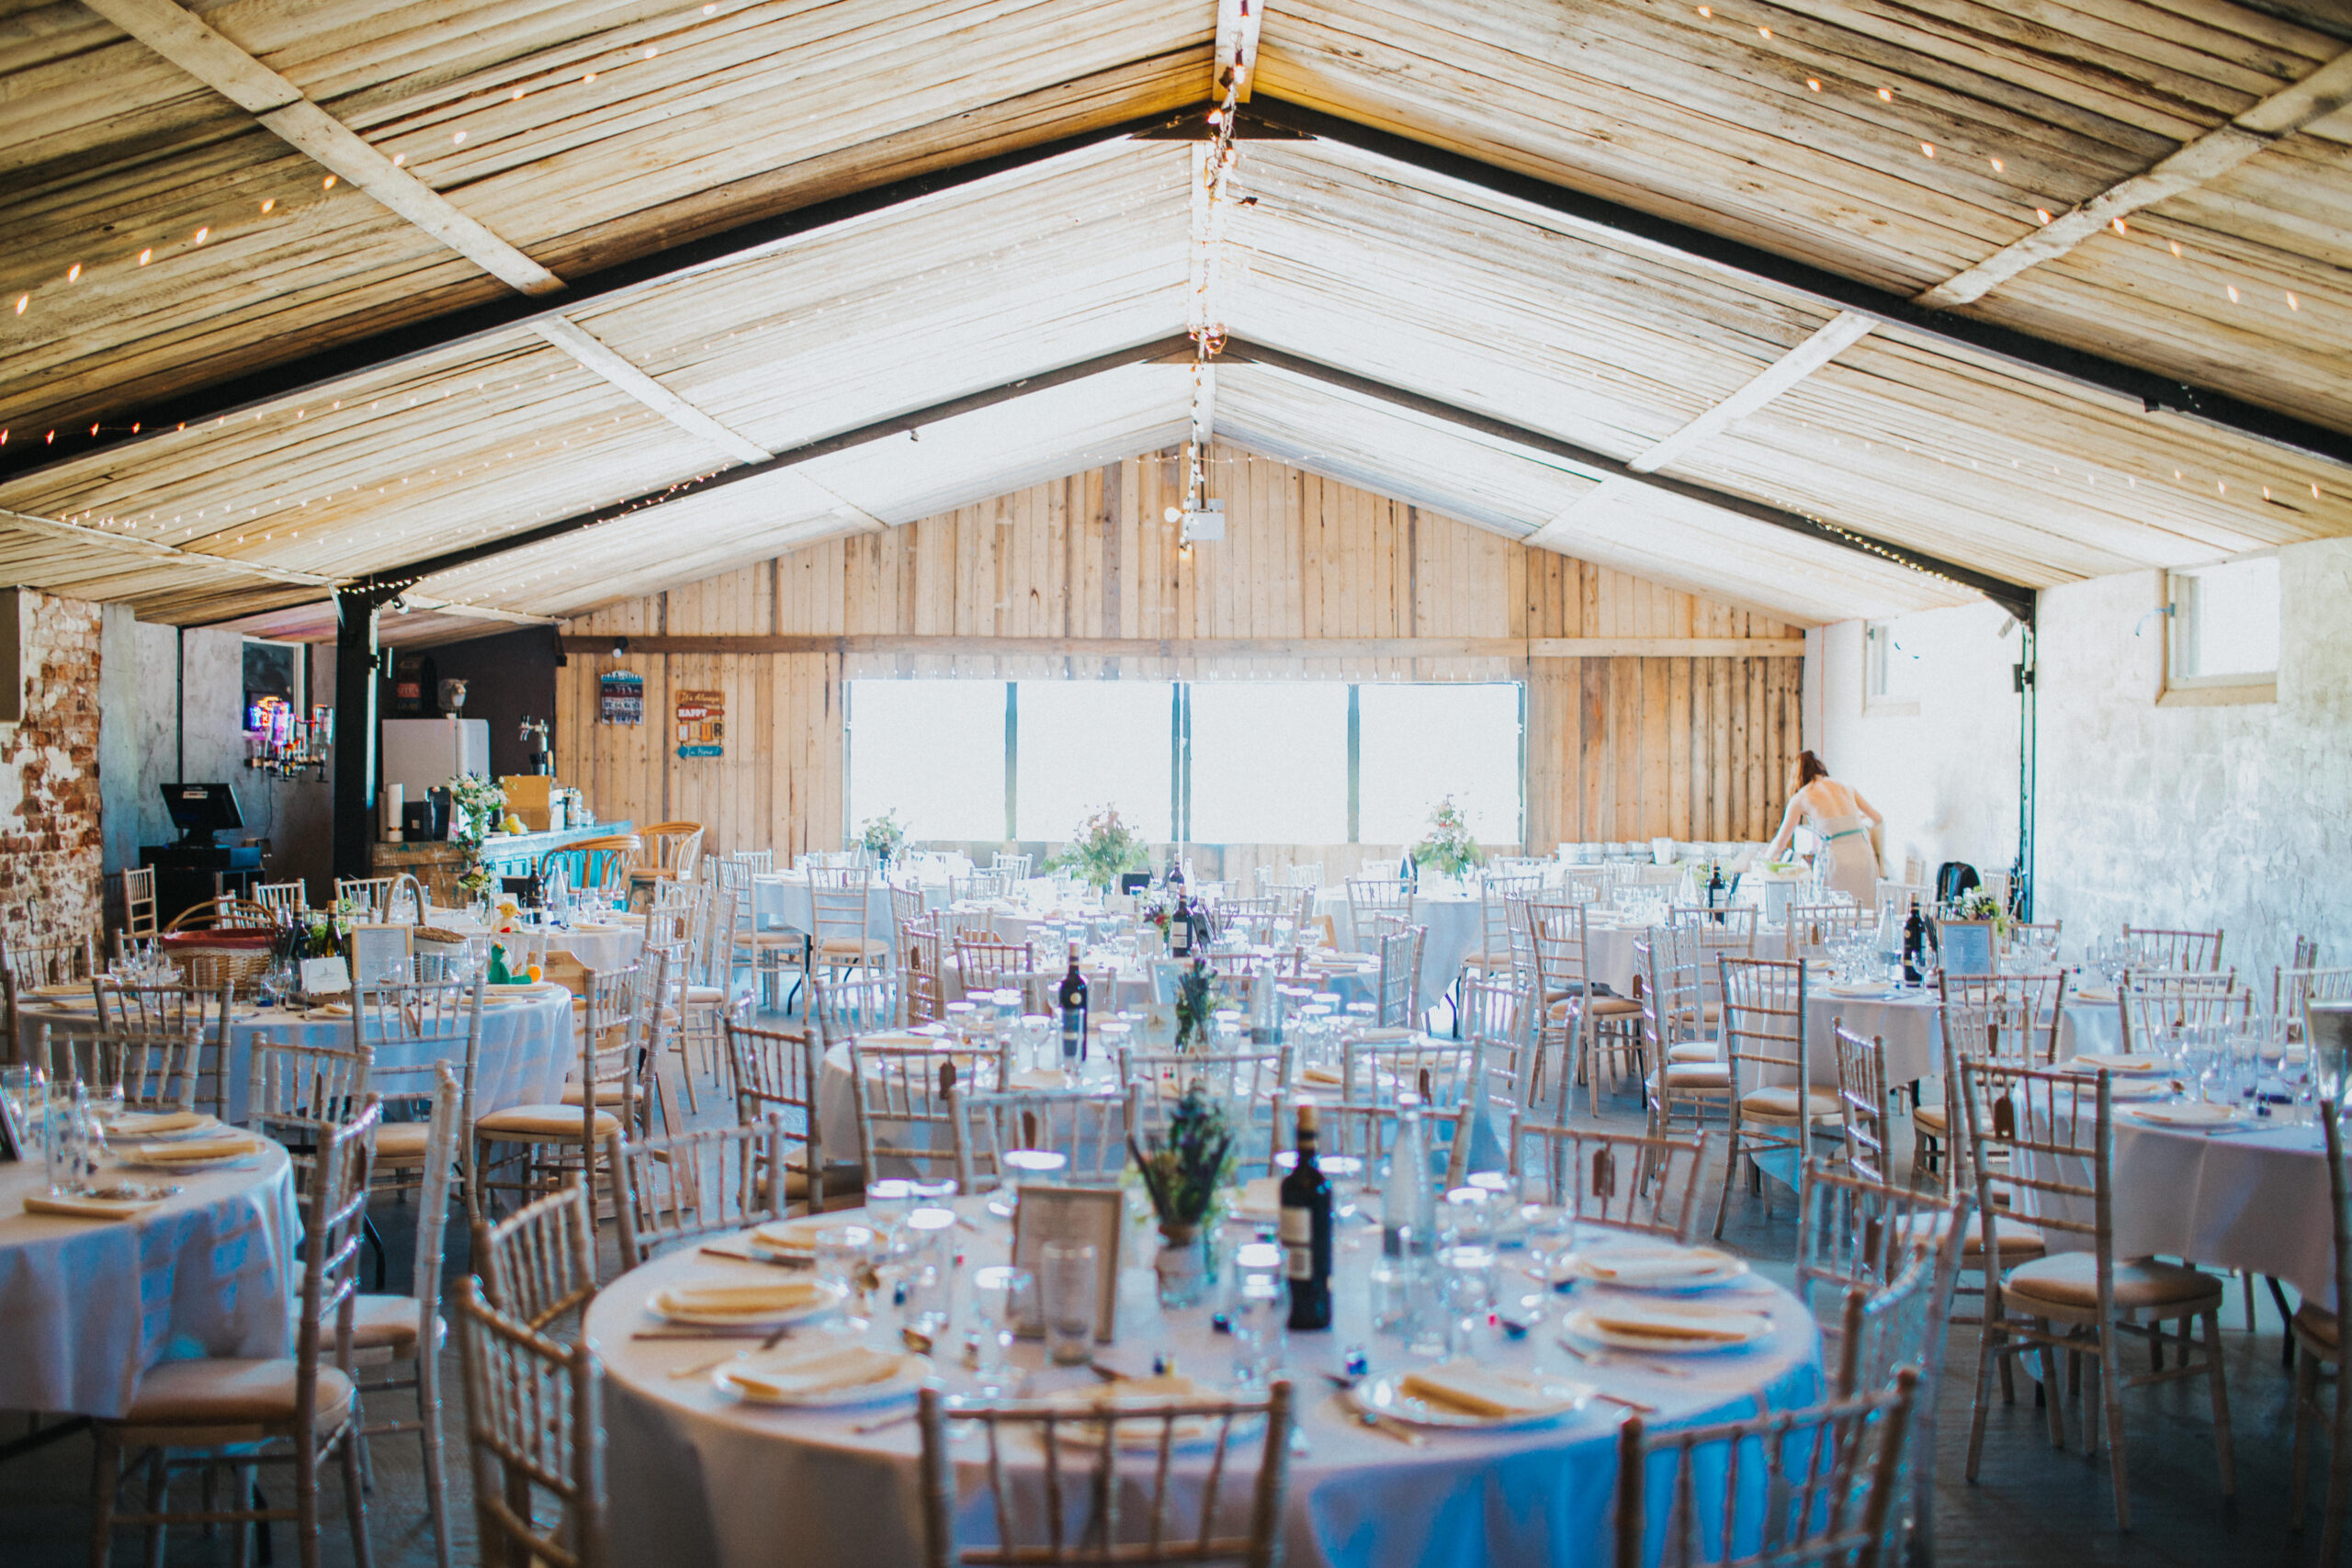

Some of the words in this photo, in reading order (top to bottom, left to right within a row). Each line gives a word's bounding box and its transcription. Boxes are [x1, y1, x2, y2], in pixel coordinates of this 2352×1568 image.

[695, 693, 719, 704] Always
[678, 708, 707, 717] HAPPY
[678, 722, 722, 741] HOUR
